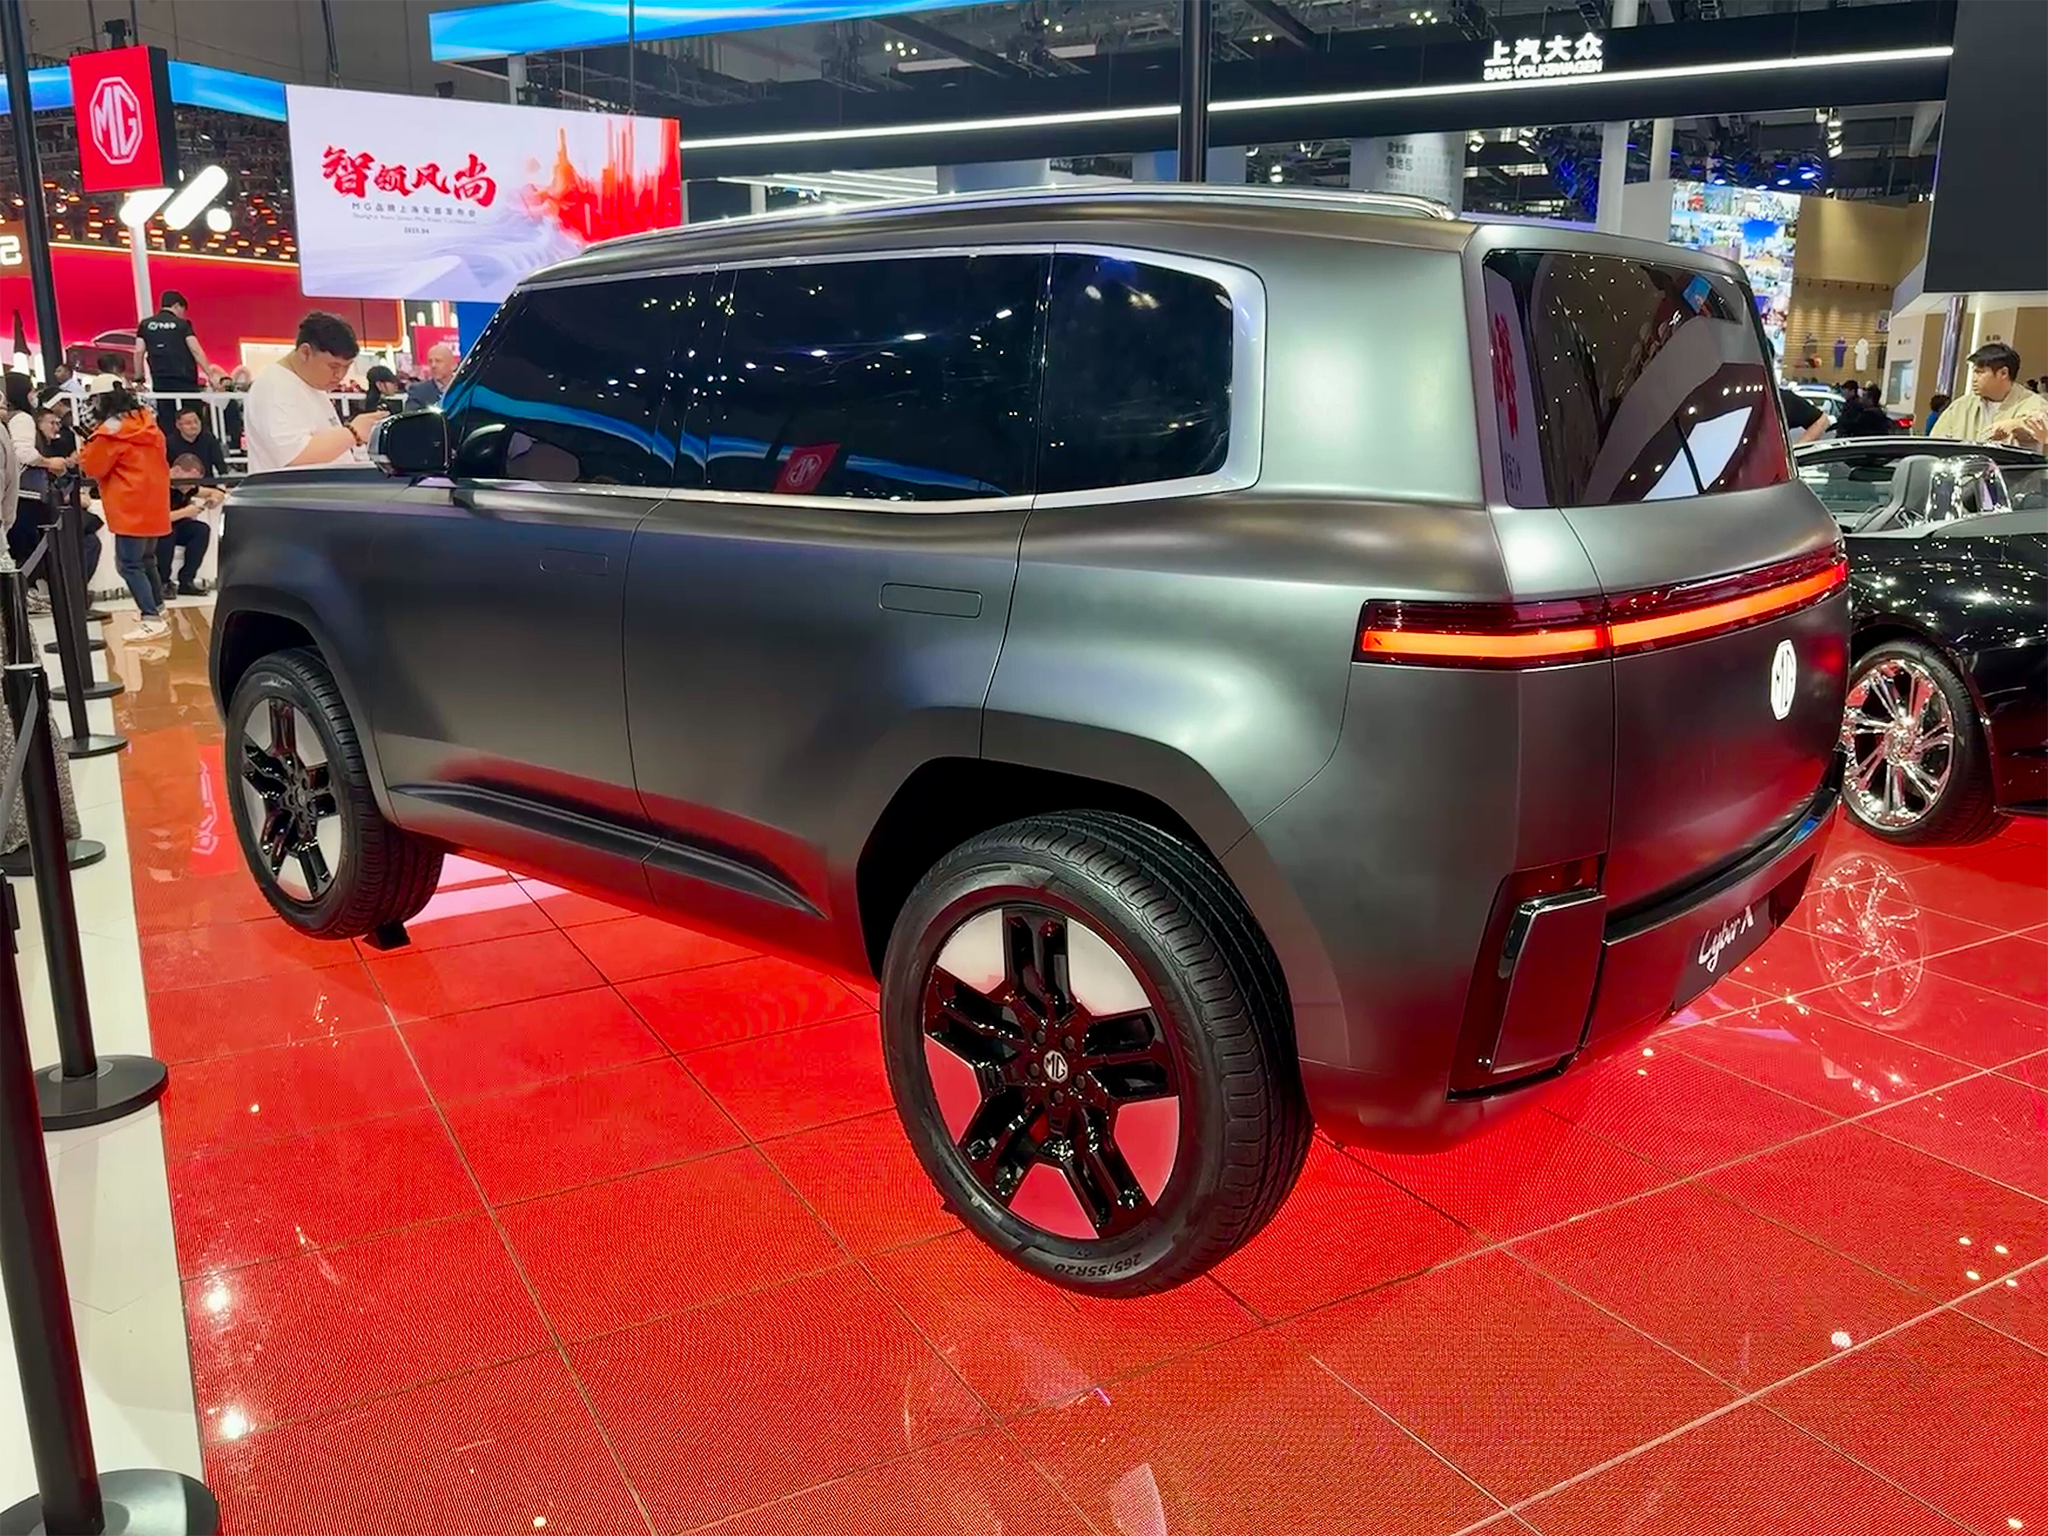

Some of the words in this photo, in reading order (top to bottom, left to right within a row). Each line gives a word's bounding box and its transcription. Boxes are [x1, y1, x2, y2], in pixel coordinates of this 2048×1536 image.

[1484, 32, 1603, 67] 上汽大众
[1483, 66, 1513, 80] SAIC
[1513, 59, 1603, 78] VOLKSWAGEN
[93, 83, 139, 158] MG
[322, 145, 497, 207] 智领风尚
[1698, 918, 1740, 973] Cyber
[1740, 905, 1754, 934] X
[1045, 1053, 1067, 1080] MG
[1054, 1252, 1142, 1277] 265/55R20
